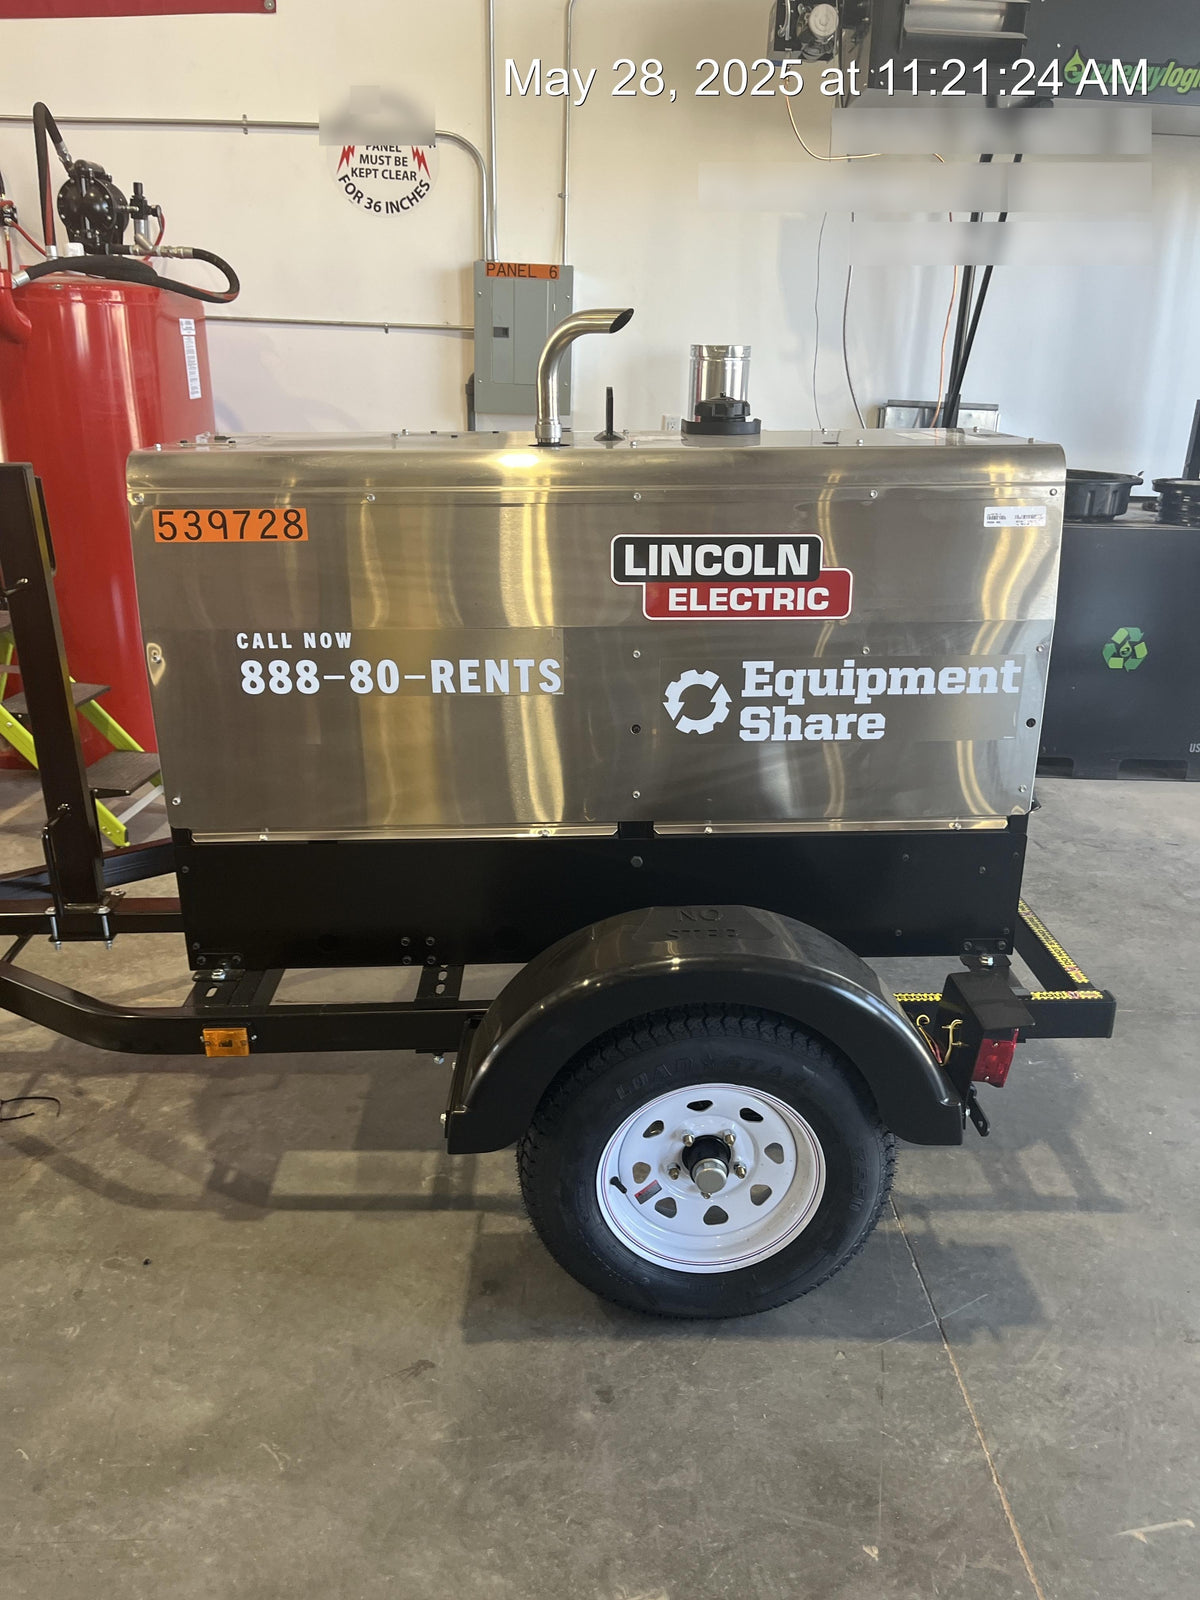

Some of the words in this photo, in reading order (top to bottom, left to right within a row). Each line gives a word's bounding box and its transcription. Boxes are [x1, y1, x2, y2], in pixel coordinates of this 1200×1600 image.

[351, 167, 379, 179] KEPT
[381, 169, 417, 182] CLEAR
[359, 154, 392, 167] MUST
[394, 156, 409, 167] BE
[338, 174, 364, 204] FOR
[364, 197, 382, 213] 36
[385, 179, 431, 214] INCHES
[486, 262, 537, 278] PANEL
[549, 265, 558, 279] 6
[158, 509, 304, 541] 539728
[624, 543, 809, 576] LINCOLN
[668, 587, 830, 611] ELECTRIC
[236, 632, 292, 649] CALL
[303, 632, 352, 649] NOW
[240, 659, 562, 695] 888-80-RENTS
[741, 659, 1022, 706] Equipment
[739, 705, 886, 742] Share
